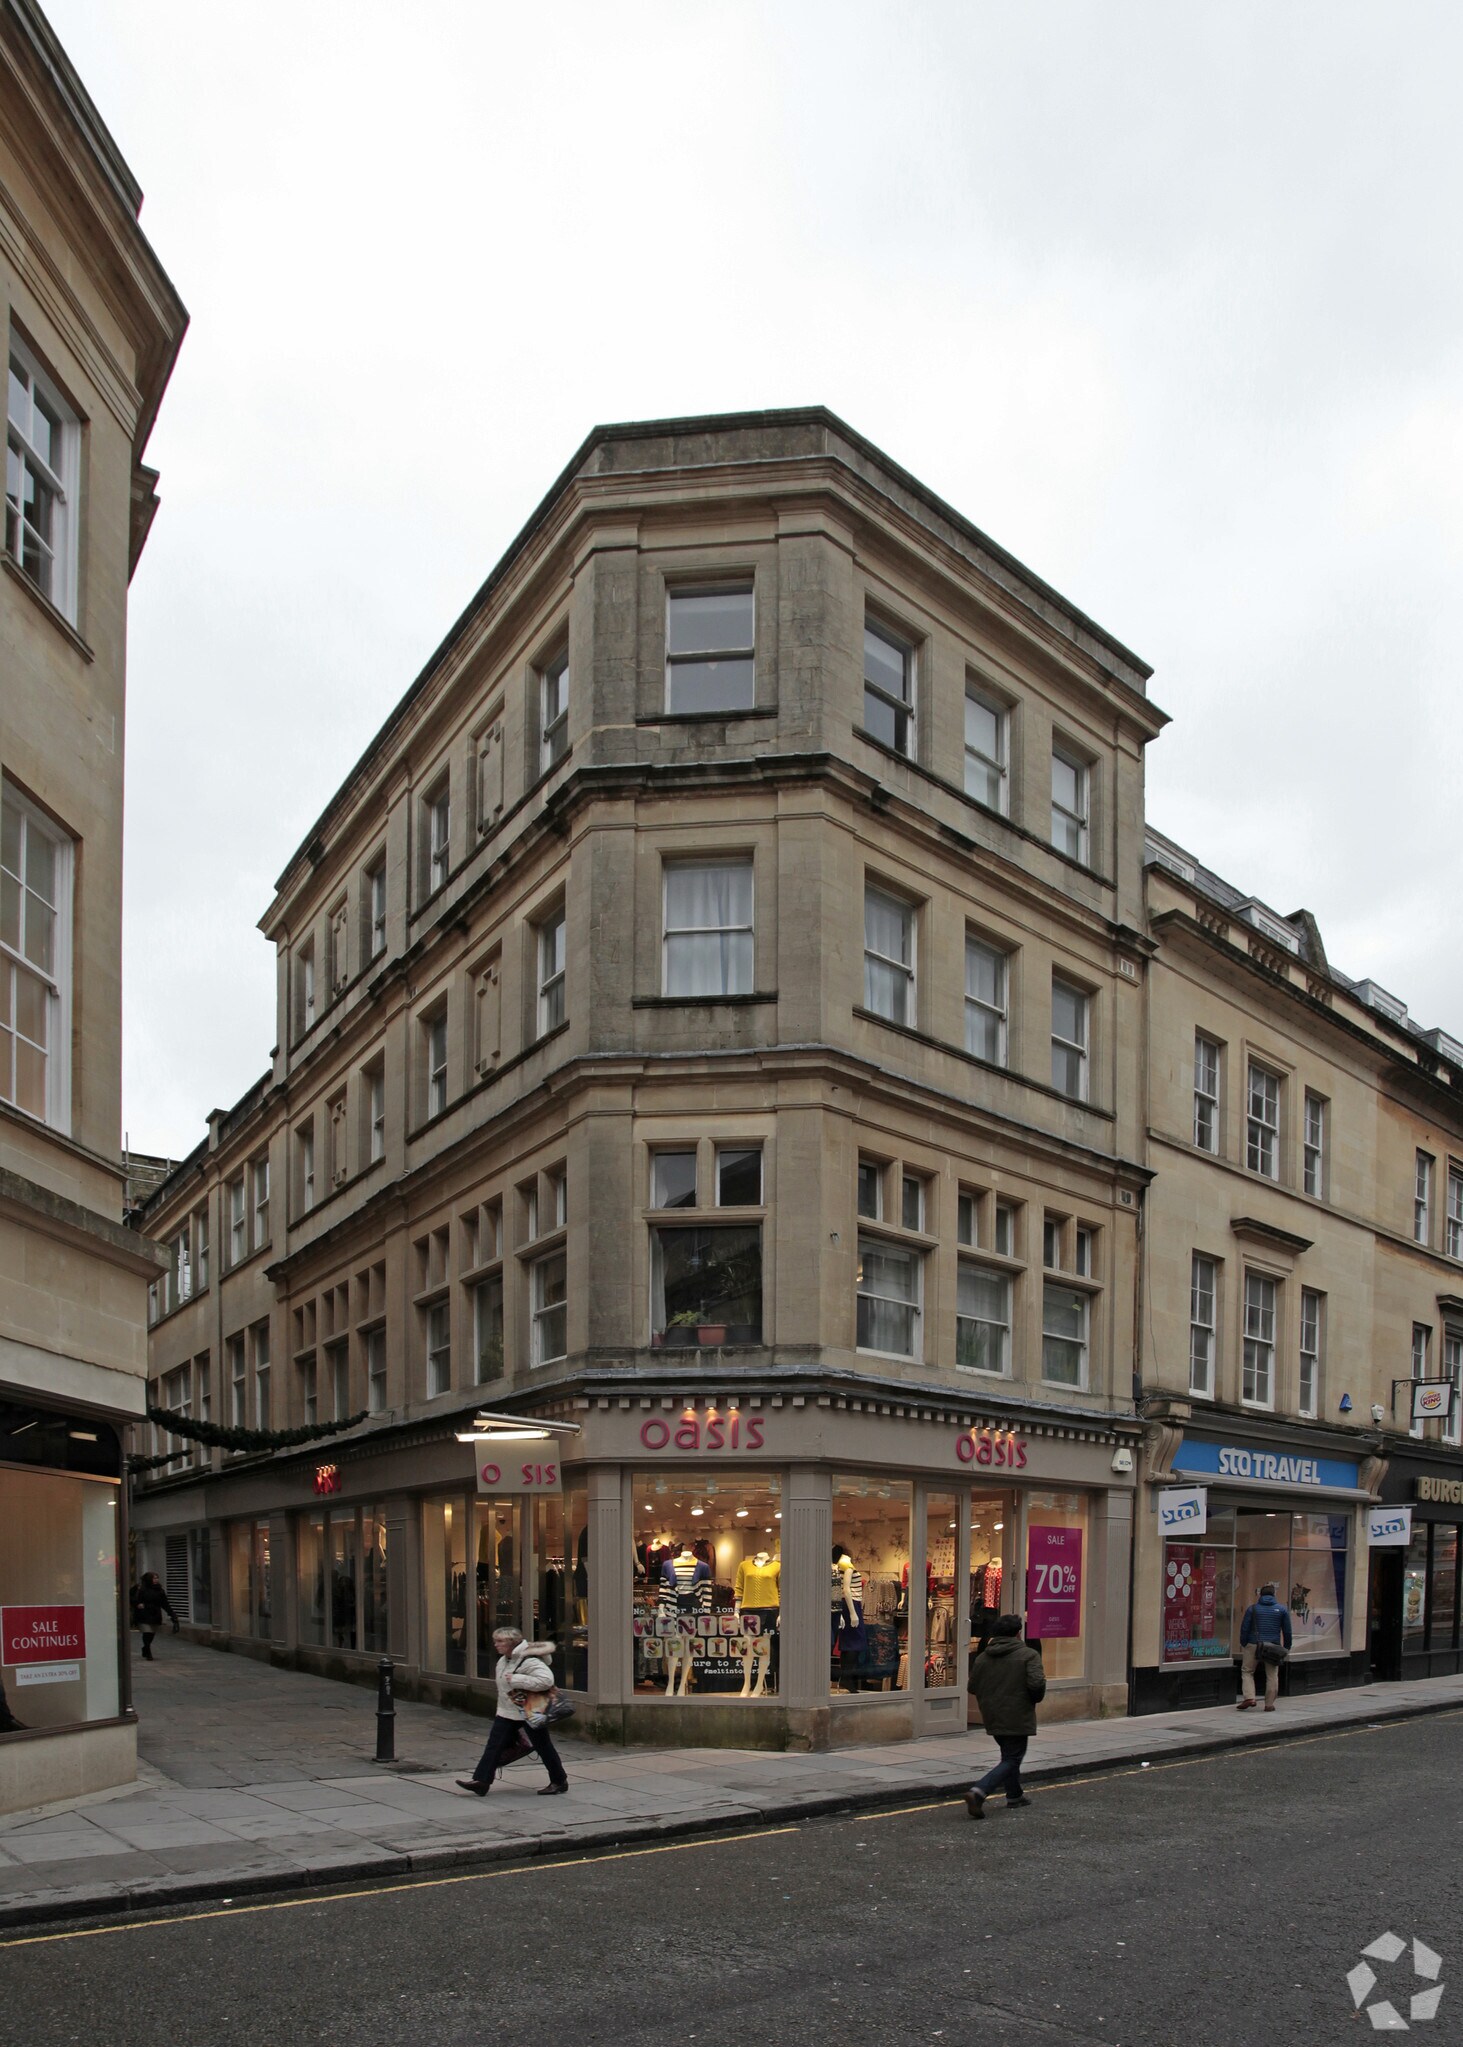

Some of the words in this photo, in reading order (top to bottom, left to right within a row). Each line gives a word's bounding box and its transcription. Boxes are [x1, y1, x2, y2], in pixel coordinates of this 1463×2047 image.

[640, 1418, 765, 1450] oasis
[956, 1433, 1028, 1468] oasis
[1252, 1453, 1321, 1485] TRAVEL
[1047, 1535, 1065, 1545] SALE
[1035, 1564, 1077, 1594] 70%
[1063, 1585, 1076, 1593] OFF
[633, 1607, 645, 1615] No
[651, 1605, 686, 1614] mter
[32, 1621, 58, 1633] SALE
[633, 1615, 759, 1636] WINTER
[12, 1634, 79, 1650] CONTINUES
[644, 1637, 769, 1658] SPRING
[704, 1667, 770, 1675] #meltintorig
